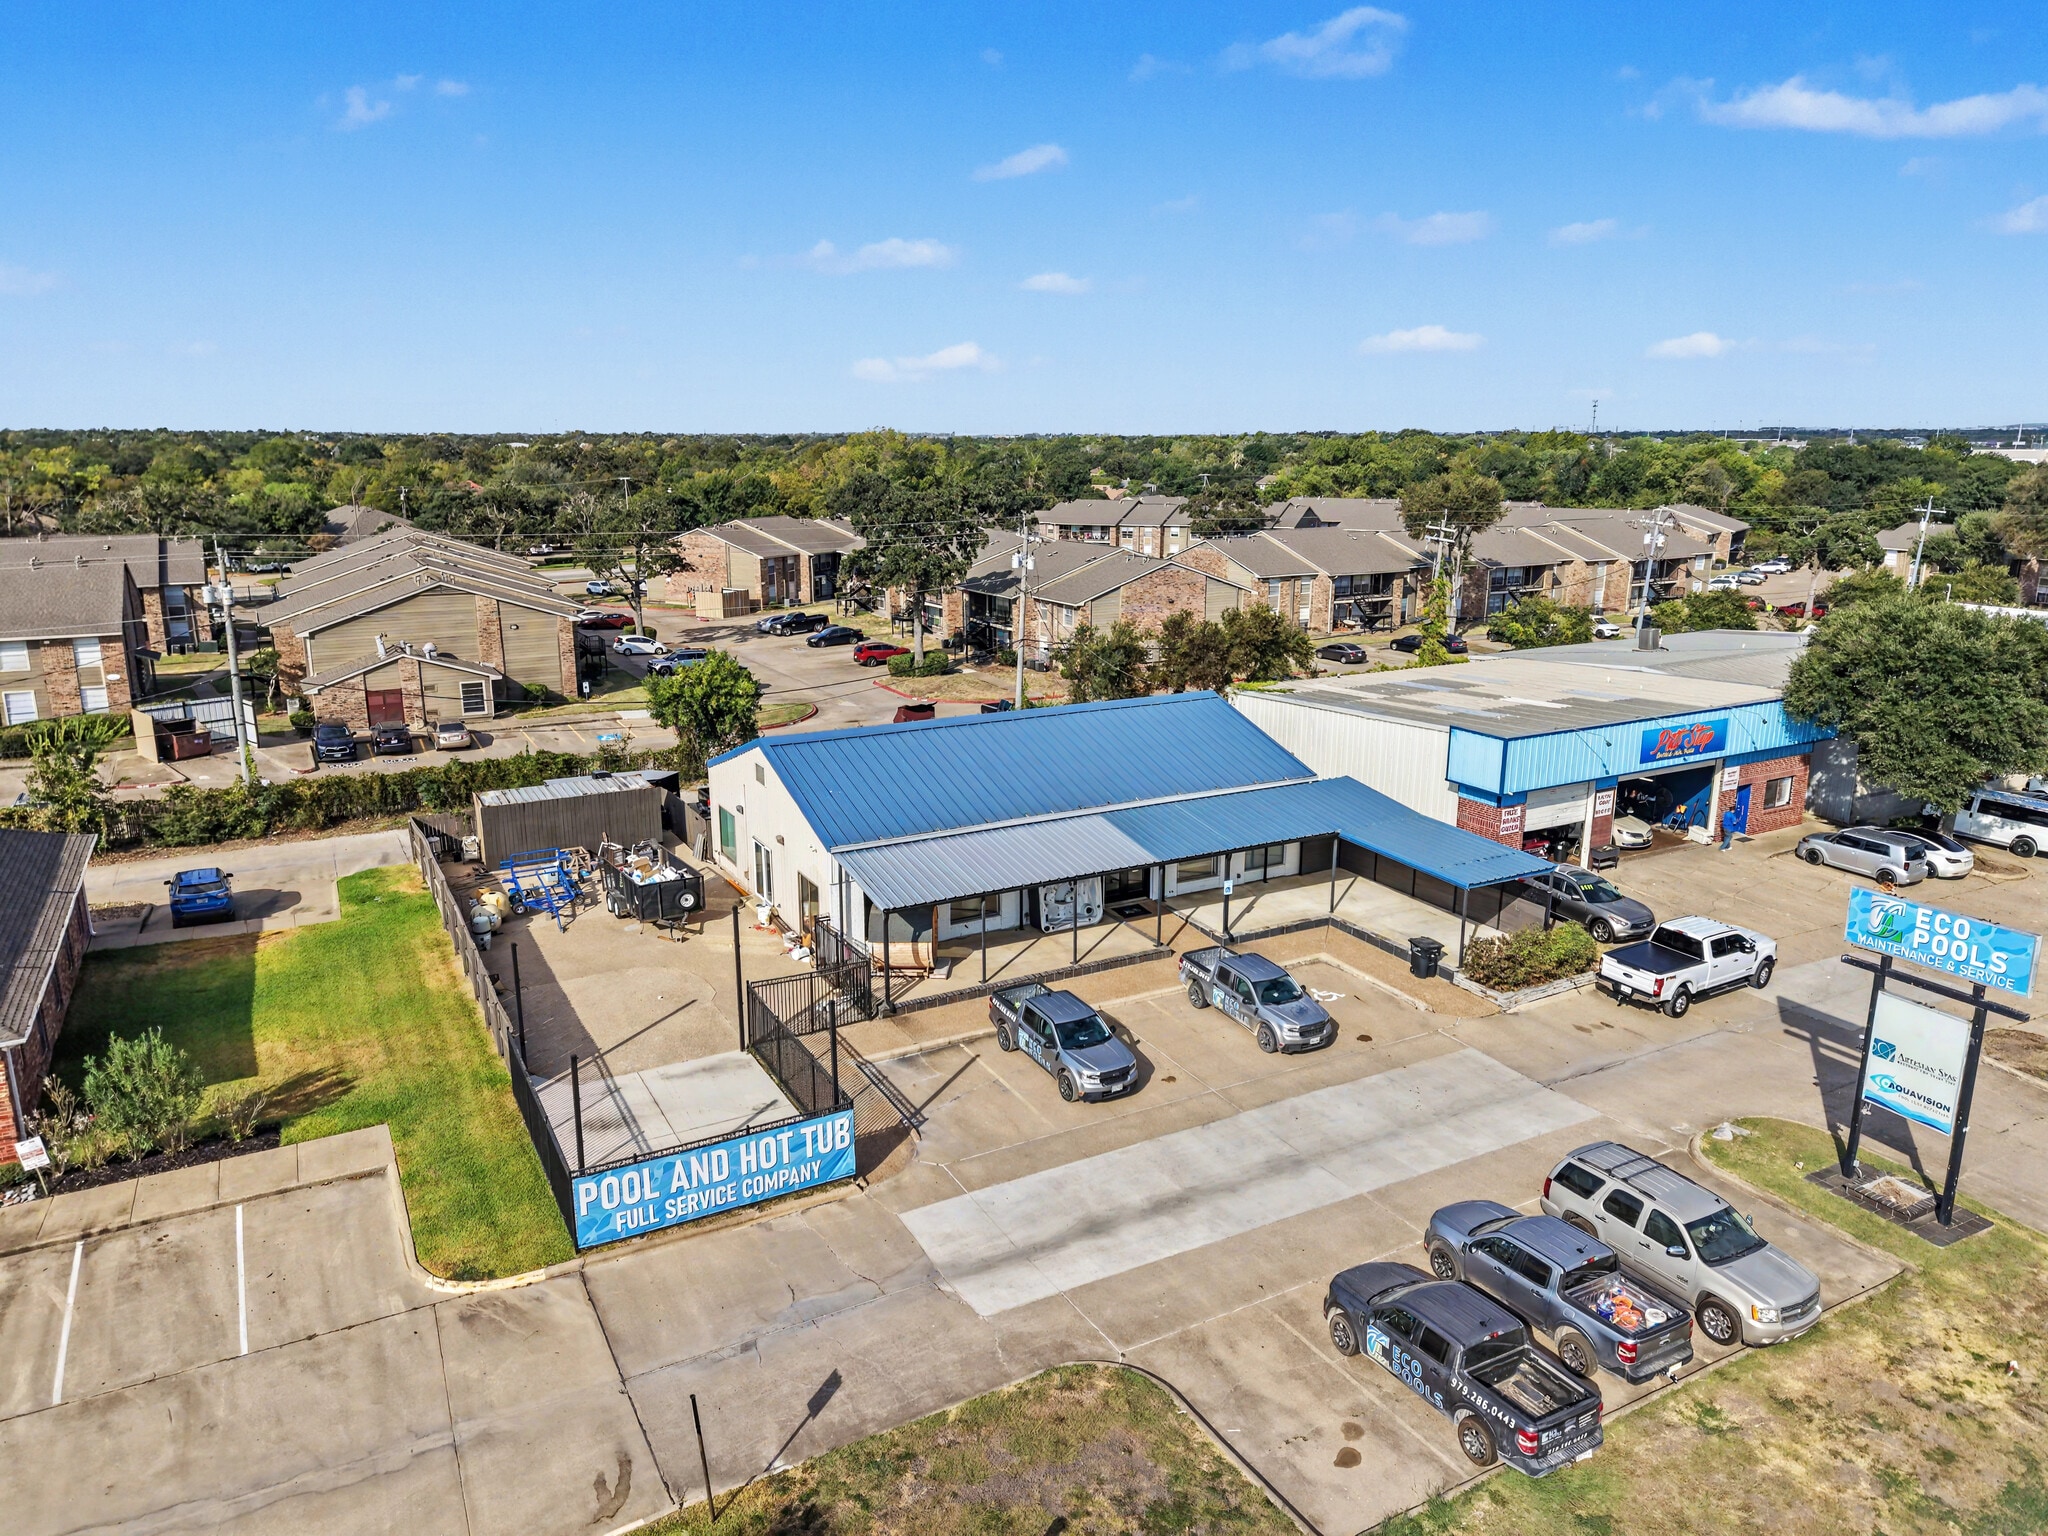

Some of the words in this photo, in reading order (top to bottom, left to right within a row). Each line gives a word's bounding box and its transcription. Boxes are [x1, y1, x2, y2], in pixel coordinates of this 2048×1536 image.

[1915, 907, 1971, 940] ECO
[1857, 933, 1943, 969] MAINTENANCE
[1946, 960, 1955, 971] &
[1959, 964, 2016, 990] SERVICE
[1912, 928, 2009, 974] POOLS
[1888, 1082, 1951, 1113] AQUAVISION
[578, 1170, 660, 1216] POOL
[670, 1150, 729, 1194] AND
[740, 1131, 793, 1176] HOT
[800, 1117, 851, 1159] TUB
[615, 1203, 660, 1232] FULL
[665, 1182, 738, 1220] SERVICE
[742, 1160, 822, 1198] COMPANY
[1392, 1344, 1423, 1378] ECO
[1392, 1362, 1444, 1410] POOLS
[1449, 1377, 1516, 1429] 979.286.0443
